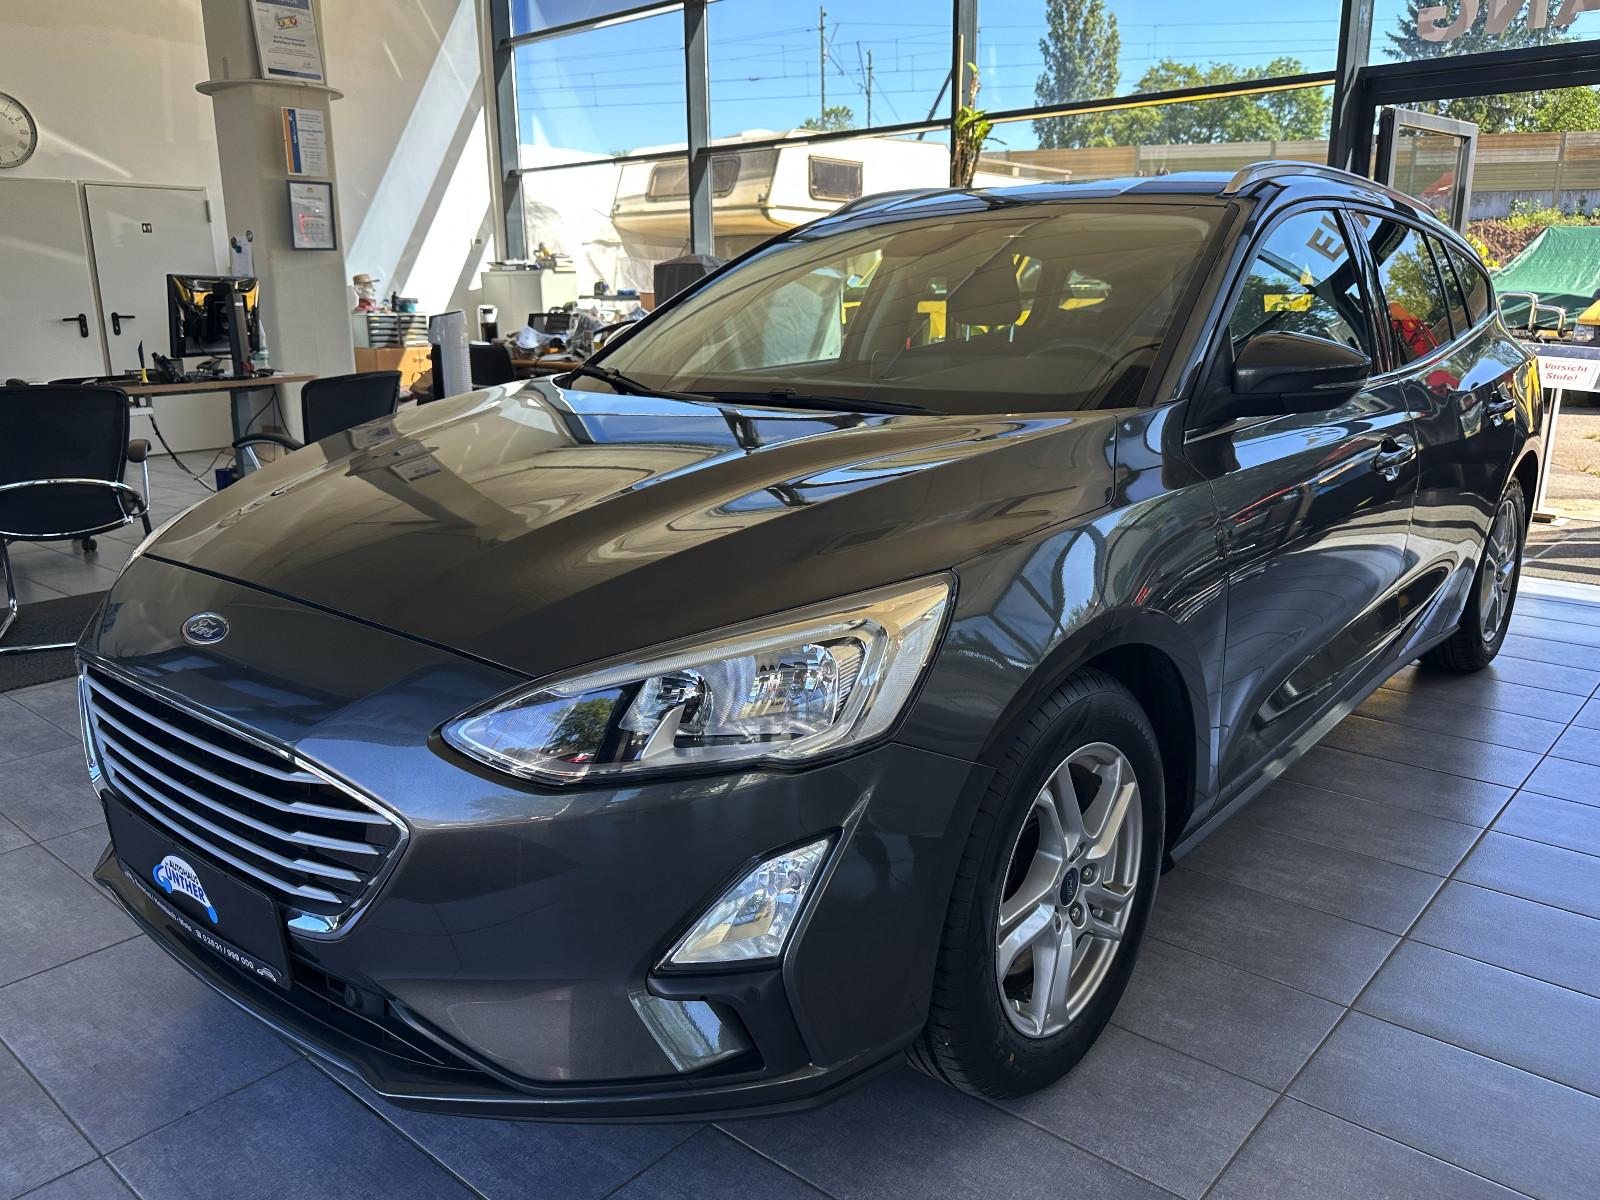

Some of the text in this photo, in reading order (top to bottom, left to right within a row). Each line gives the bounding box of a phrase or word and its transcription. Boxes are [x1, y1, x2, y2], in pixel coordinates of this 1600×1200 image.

[1545, 362, 1588, 372] Vorsicht
[1546, 372, 1578, 381] Stufe!
[190, 618, 220, 638] Ford
[168, 860, 199, 885] AUTOHAUS
